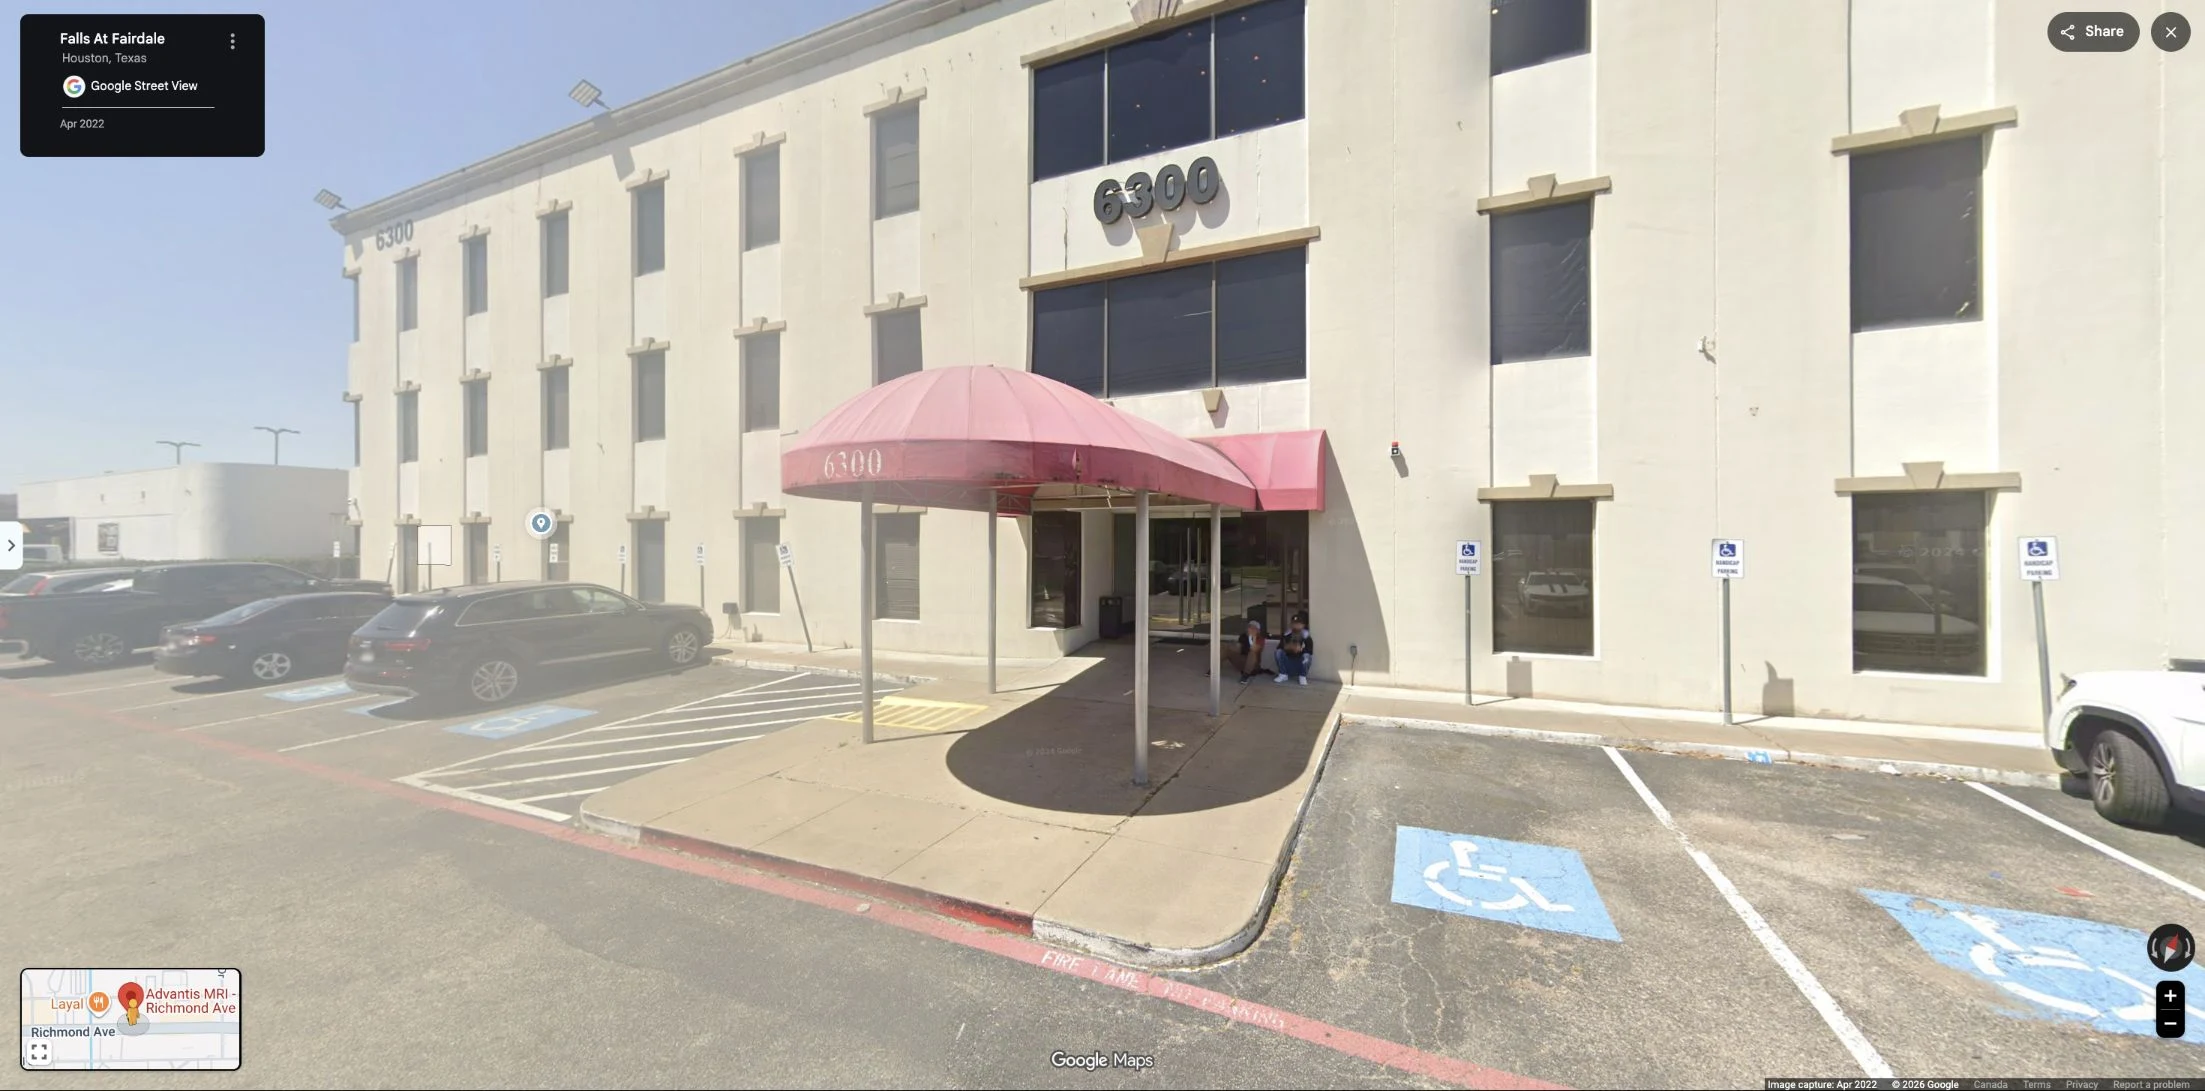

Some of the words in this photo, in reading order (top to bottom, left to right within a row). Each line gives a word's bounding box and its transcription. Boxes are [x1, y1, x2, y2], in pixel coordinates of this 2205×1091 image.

[1093, 156, 1220, 225] 6300
[376, 219, 413, 251] 6300
[824, 448, 881, 480] 6300
[1041, 950, 1085, 971] FIRE
